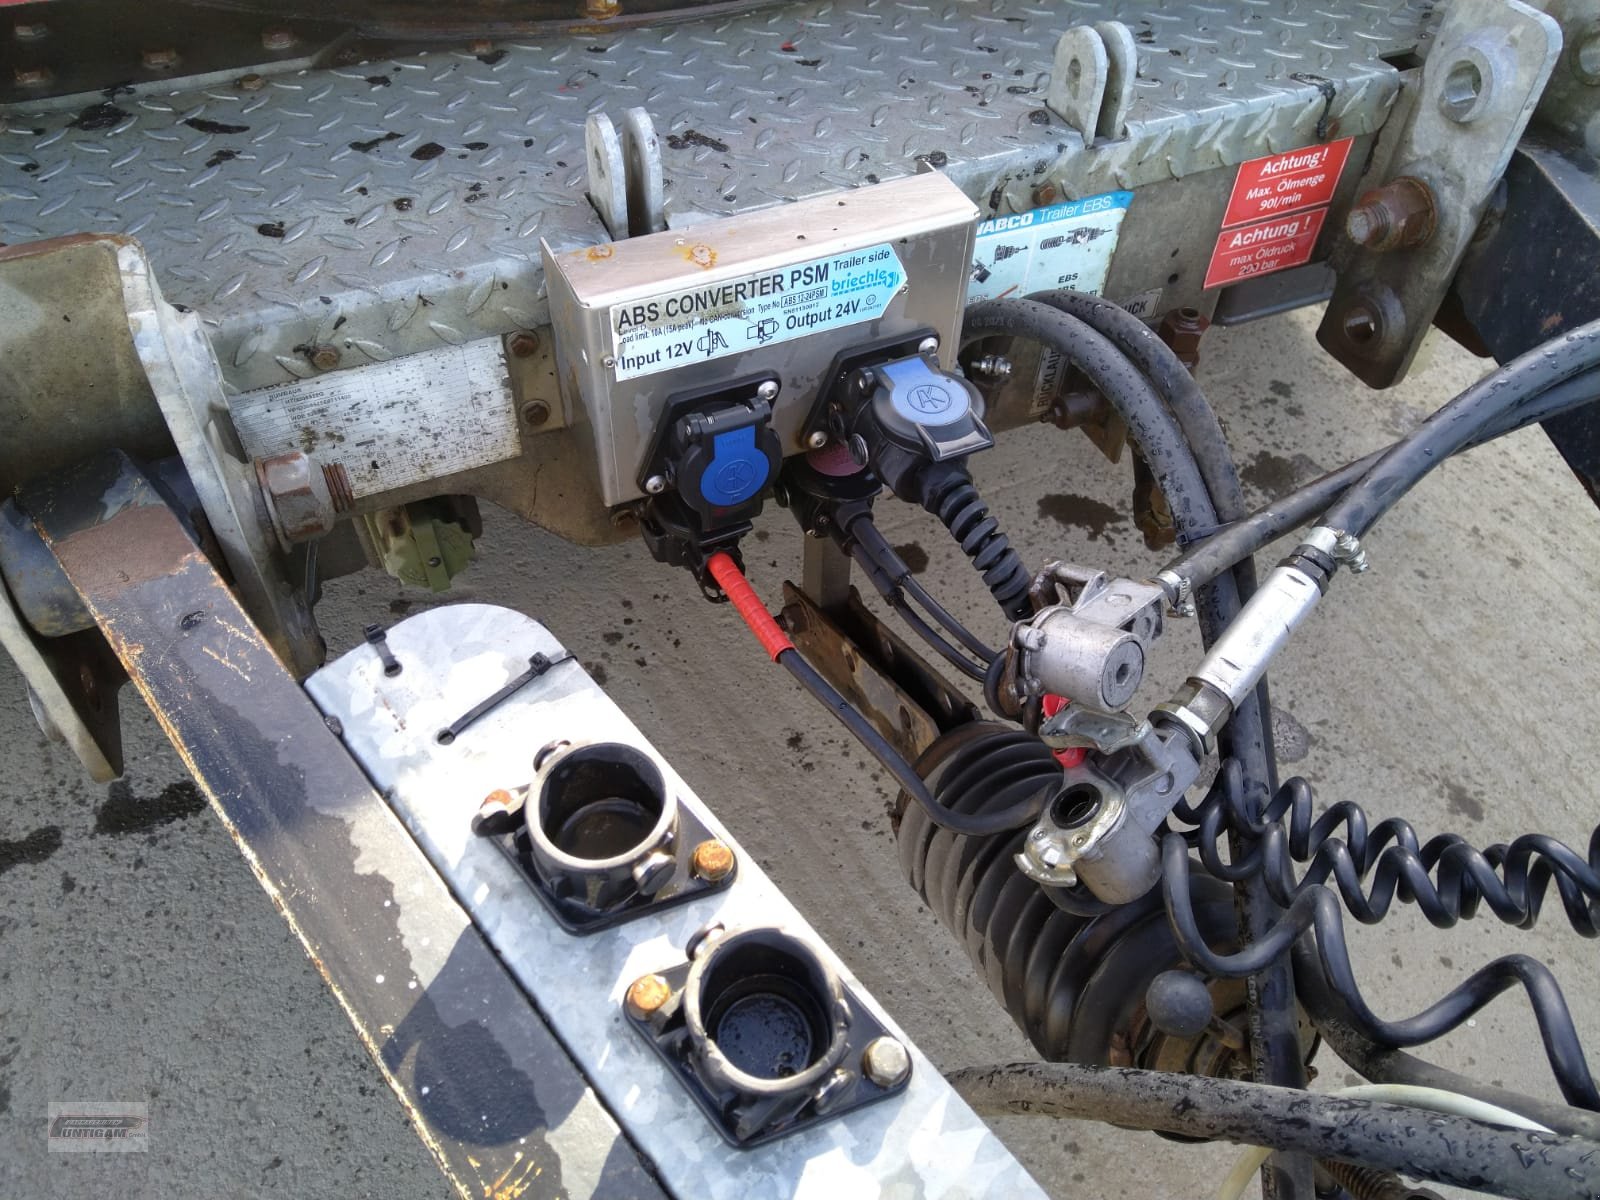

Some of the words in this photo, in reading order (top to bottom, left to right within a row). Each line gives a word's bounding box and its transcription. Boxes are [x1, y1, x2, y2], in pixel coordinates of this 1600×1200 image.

[1246, 187, 1272, 200] Max.
[1277, 173, 1325, 193] Ölmenge
[1039, 204, 1081, 222] Trailer
[1082, 195, 1113, 214] EBS
[1229, 220, 1300, 248] Achtung
[833, 256, 867, 271] Trailer
[868, 250, 890, 264] side
[1256, 242, 1295, 260] Öldruck
[1261, 259, 1280, 270] bar
[831, 268, 888, 292] briechle
[618, 302, 660, 328] ABS
[665, 274, 784, 318] CONVERTER
[790, 262, 829, 289] PSM
[757, 303, 771, 314] Type
[772, 299, 780, 309] No
[785, 306, 832, 330] Output
[835, 299, 860, 319] 24V
[1124, 300, 1148, 315] UCK
[619, 335, 634, 345] oad
[620, 348, 661, 370] Input
[665, 340, 693, 359] 12V
